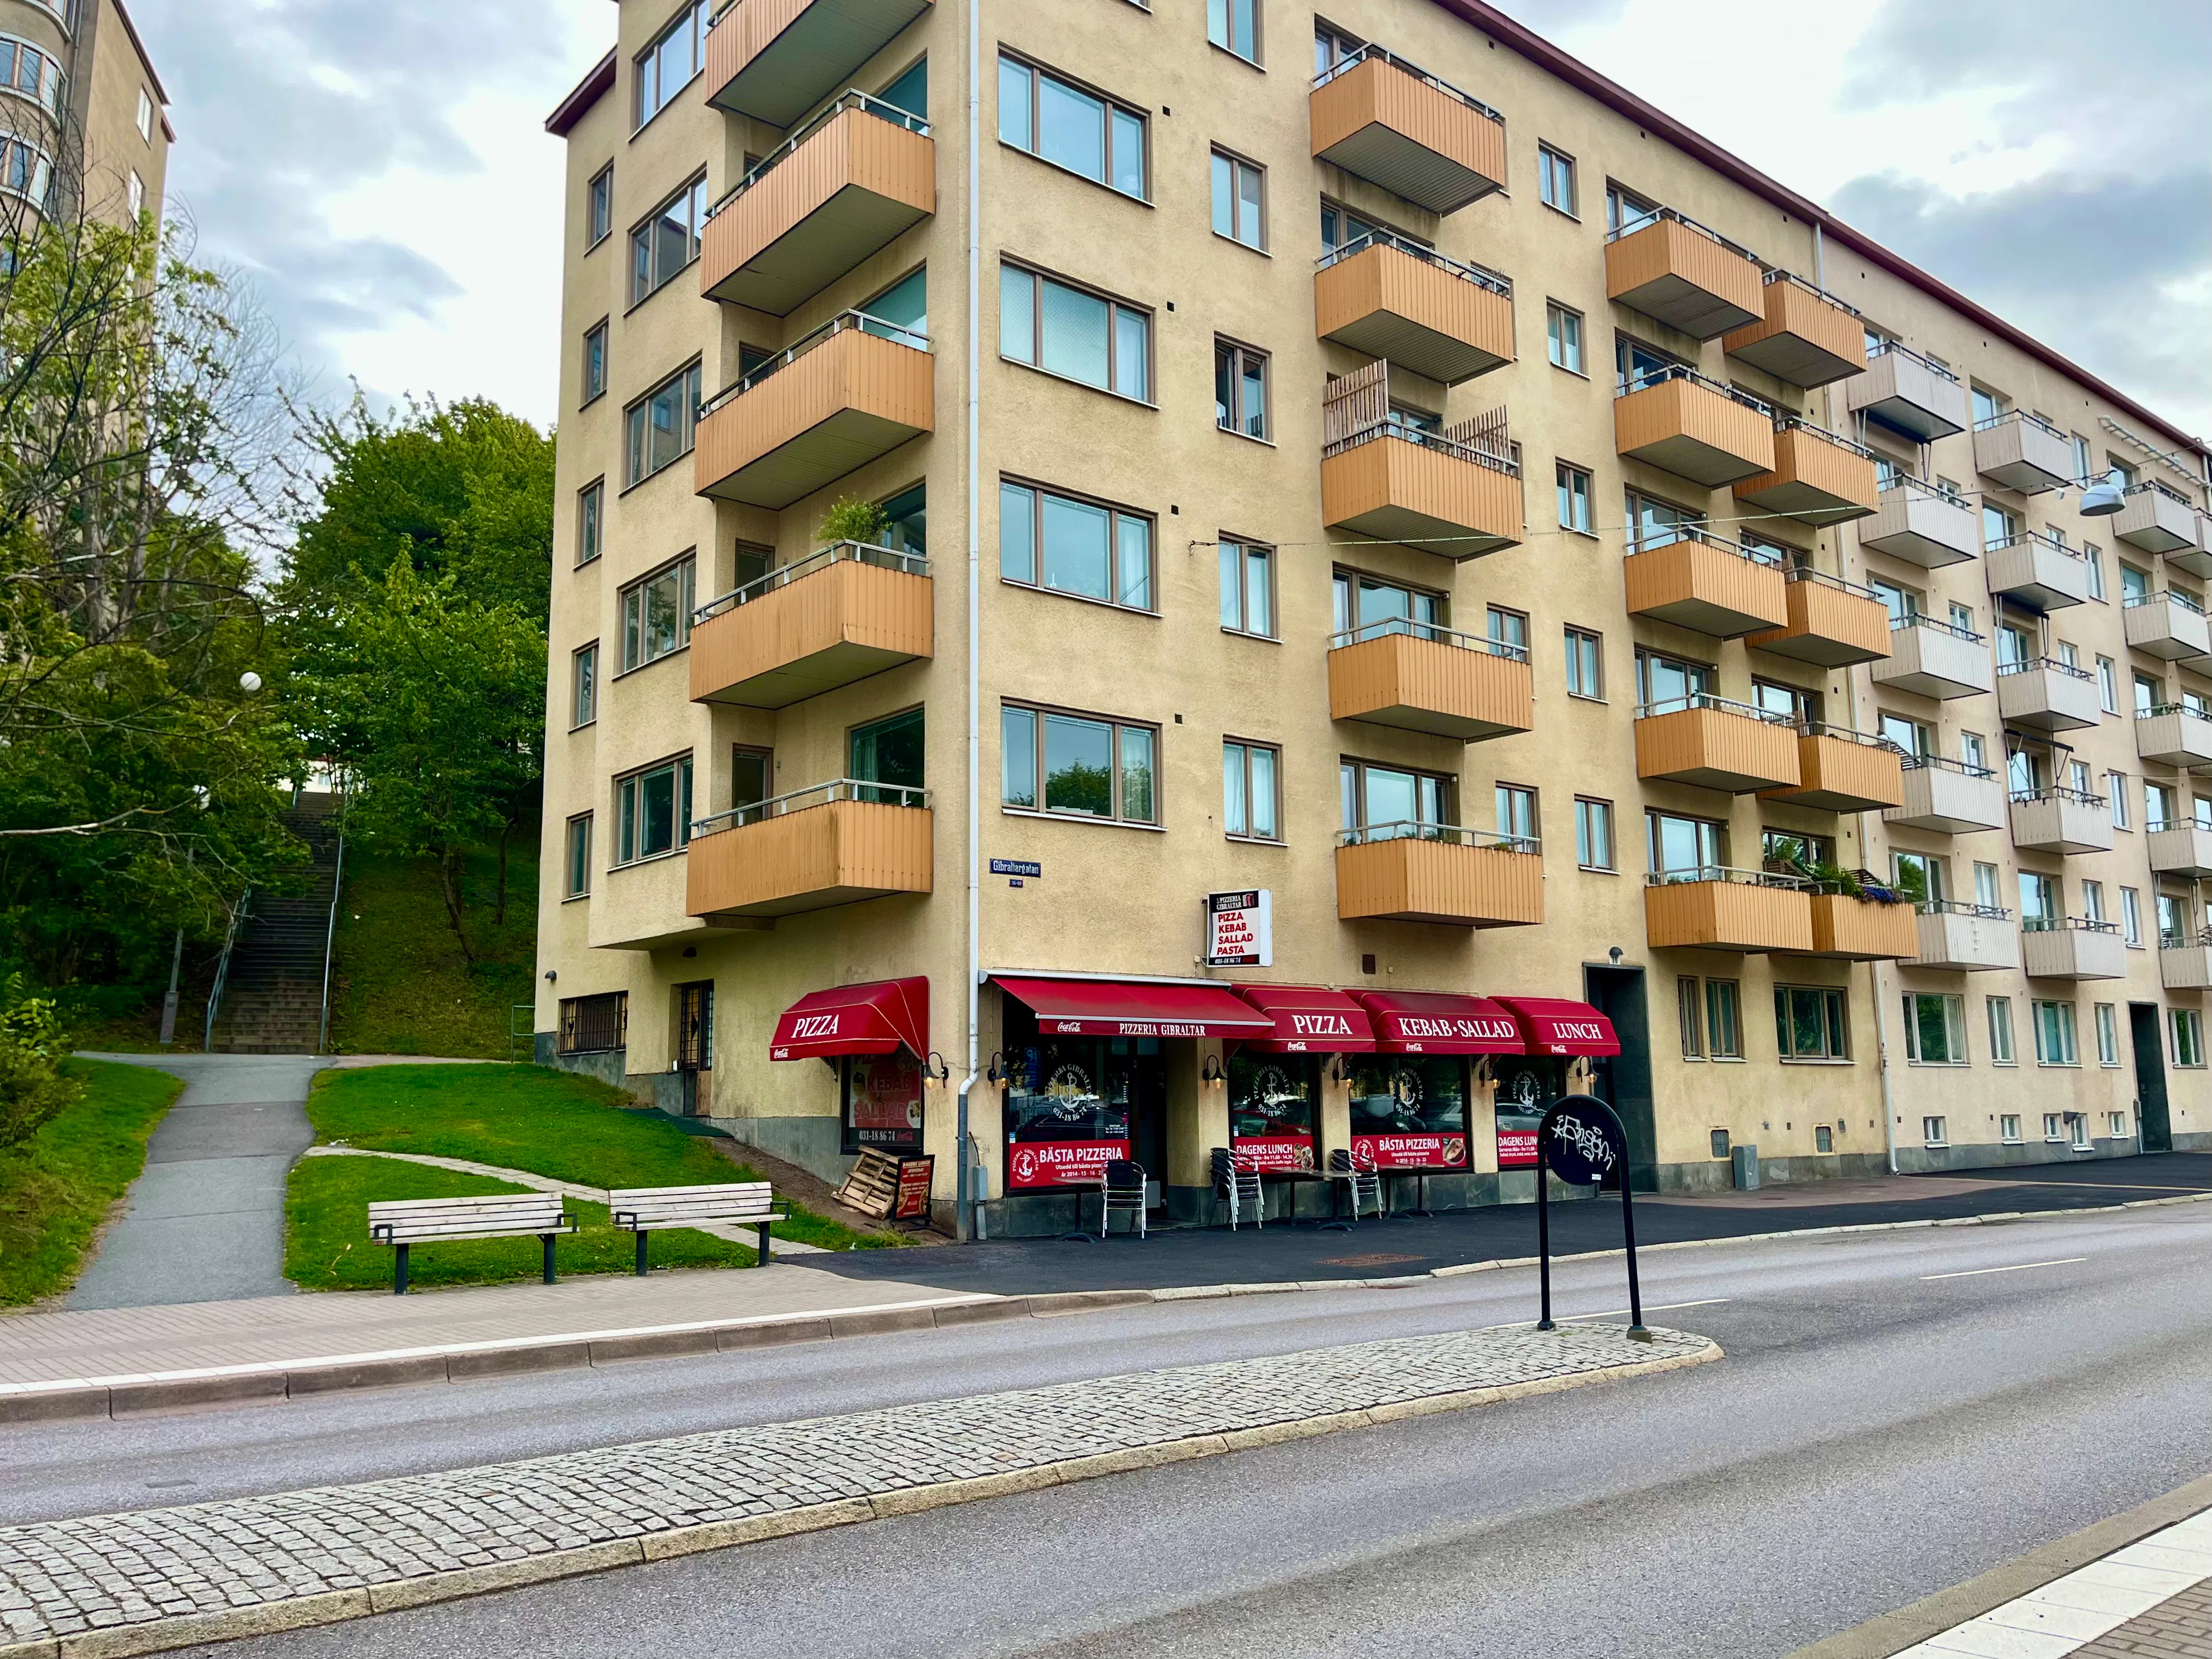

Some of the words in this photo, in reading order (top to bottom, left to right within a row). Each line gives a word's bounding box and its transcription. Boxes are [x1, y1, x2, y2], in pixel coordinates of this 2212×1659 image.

[993, 860, 1039, 874] Gibraltargatan
[1216, 902, 1242, 910] GIBRALTAR
[1220, 895, 1241, 904] PIZZERIA
[1218, 912, 1244, 922] PIZZA
[1218, 922, 1246, 934] KEBAB
[1218, 933, 1253, 945] SALLAD
[1217, 946, 1245, 955] PASTA
[791, 1014, 839, 1038] PIZZA
[1119, 1023, 1158, 1034] PIZZERIA
[1161, 1025, 1205, 1036] GIBRALTAR
[1291, 1015, 1353, 1034] PIZZA
[1398, 1018, 1452, 1036] KEBAB
[1457, 1020, 1515, 1037] SALLAD
[1552, 1023, 1603, 1039] LUNCH
[868, 1074, 912, 1091] KEBAB
[854, 1102, 907, 1120] SALLAD
[859, 1130, 878, 1140] 031-18
[880, 1130, 887, 1141] 86
[888, 1131, 895, 1141] 74
[1498, 1136, 1524, 1147] DAGENS
[1524, 1136, 1538, 1145] LUN
[1236, 1144, 1267, 1155] DAGENS
[1268, 1144, 1292, 1154] LUNCH
[1379, 1138, 1405, 1151] BÄSTA
[1406, 1138, 1440, 1150] PIZZERIA
[1040, 1147, 1074, 1163] BÄSTA
[1077, 1147, 1123, 1161] PIZZERIA
